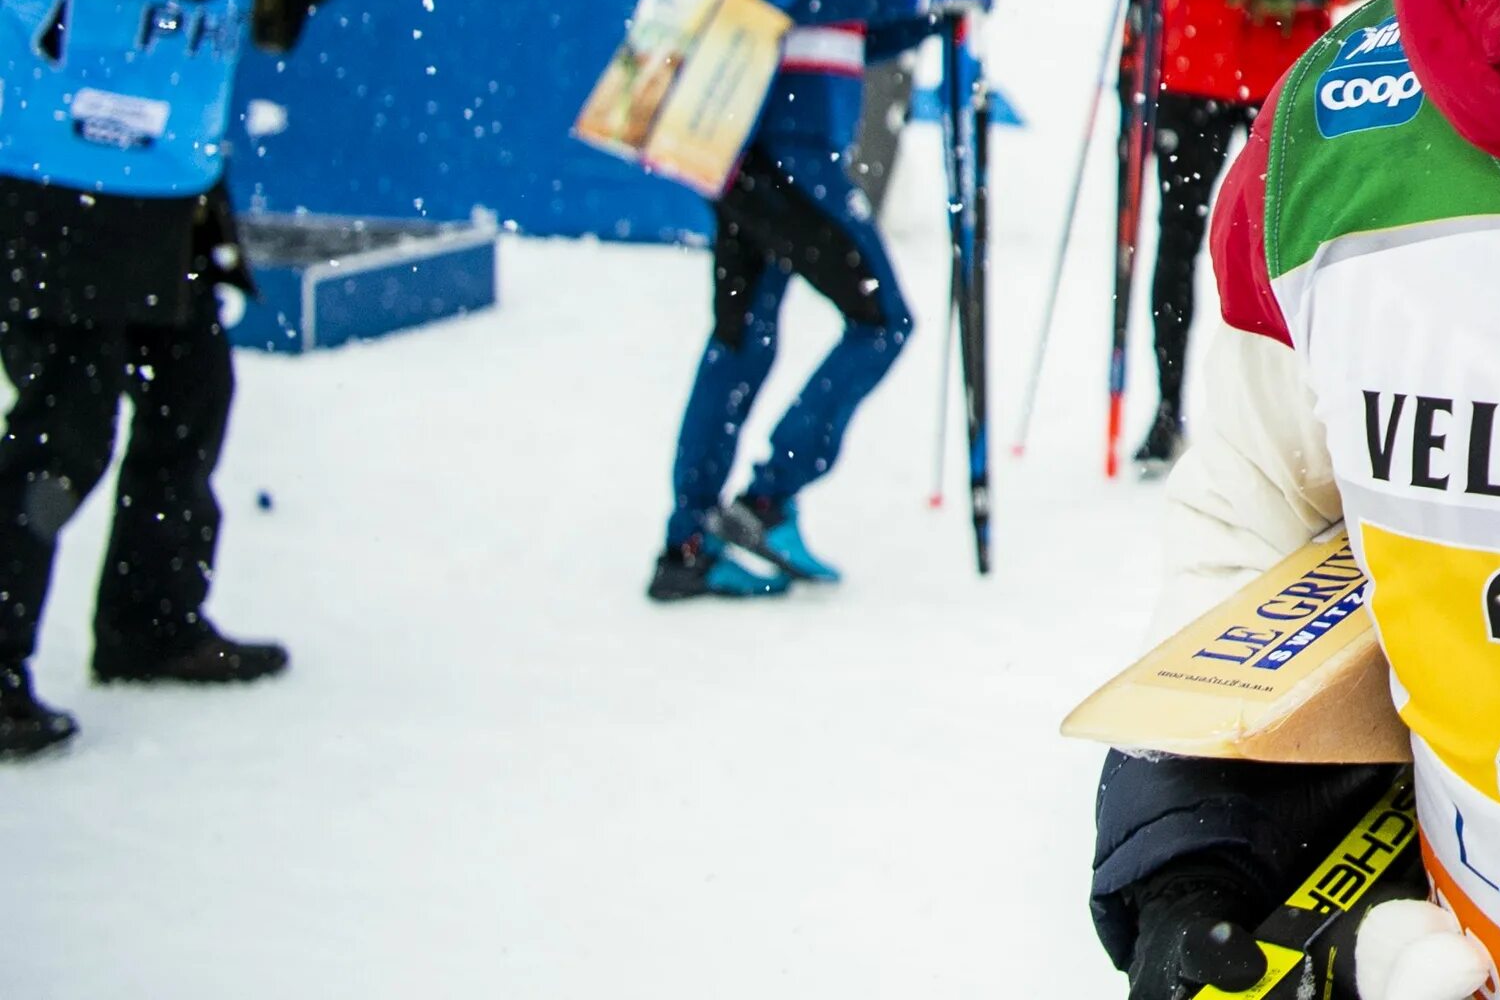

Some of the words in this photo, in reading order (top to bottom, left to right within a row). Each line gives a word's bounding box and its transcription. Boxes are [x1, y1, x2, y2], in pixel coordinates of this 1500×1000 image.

[1320, 71, 1422, 111] coop
[1192, 626, 1284, 666] LE
[1256, 545, 1366, 621] GRU
[1268, 583, 1368, 664] SWITZ
